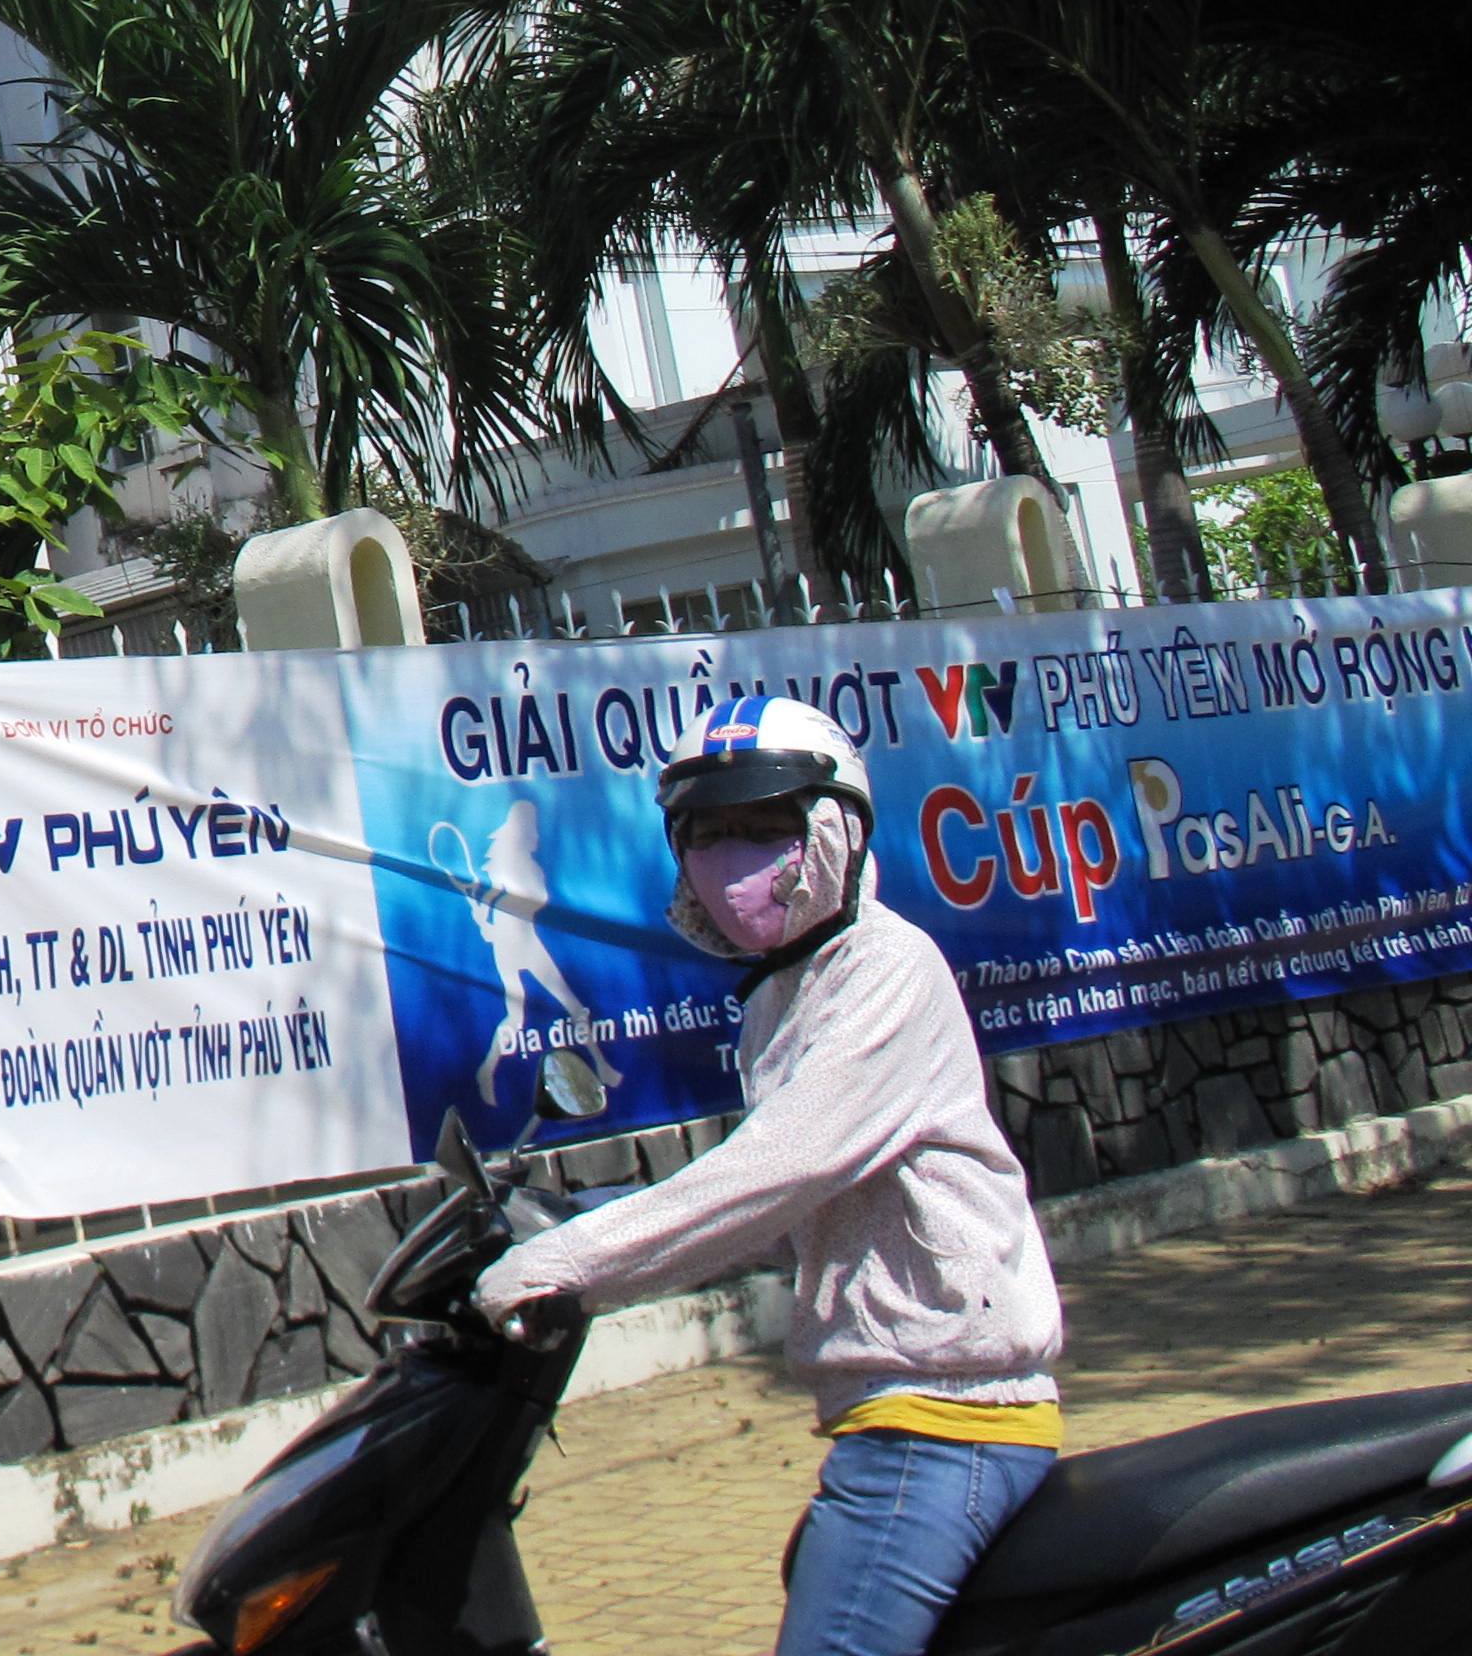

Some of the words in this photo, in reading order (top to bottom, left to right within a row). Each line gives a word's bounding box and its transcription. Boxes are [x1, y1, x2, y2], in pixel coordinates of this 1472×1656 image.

[1, 718, 46, 740] ĐƠN
[49, 719, 71, 743] VỊ
[76, 707, 105, 738] TỔ
[112, 710, 173, 737] CHỨC
[441, 662, 578, 781] GIẢI
[595, 649, 764, 771] QUẦ
[1033, 630, 1142, 733] PHÚ
[1142, 625, 1251, 721] YÊN
[1253, 614, 1327, 708] MỞ
[1333, 616, 1460, 713] RỘNG
[43, 785, 164, 872] PHÚ
[166, 785, 290, 859] YÊN
[918, 771, 1121, 925] Cúp
[26, 930, 58, 991] TT
[70, 927, 91, 987] &
[98, 924, 134, 983] DL
[137, 898, 198, 979] TỈNH
[202, 895, 253, 973] PHÚ
[259, 892, 312, 965] YÊN
[980, 999, 1022, 1030] các
[1027, 993, 1073, 1026] trận
[1077, 981, 1125, 1014] khai
[1129, 979, 1180, 1008] mạc,
[1182, 967, 1221, 996] bán
[1226, 955, 1259, 987] kết
[1261, 953, 1286, 980] và
[1290, 949, 1351, 976] chung
[1350, 933, 1385, 963] kết
[1382, 929, 1426, 958] trên
[1036, 950, 1062, 978] và
[1064, 947, 1116, 975] Cụm
[1118, 938, 1157, 964] sân
[1154, 929, 1204, 957] Liên
[1205, 922, 1255, 949] đoàn
[1254, 909, 1307, 941] Quần
[1308, 906, 1340, 935] vợt
[1339, 900, 1376, 926] tỉnh
[1377, 891, 1412, 920] Phú
[0, 1027, 60, 1108] ĐOÀN
[65, 1009, 125, 1109] QUẦN
[129, 1020, 172, 1101] VỢT
[179, 1003, 231, 1084] TỈNH
[239, 1000, 282, 1077] PHÚ
[284, 996, 332, 1072] YÊN
[497, 1025, 543, 1060] Địa
[549, 1007, 615, 1048] điểm
[623, 1005, 658, 1038] thi
[664, 995, 720, 1032] đấu:
